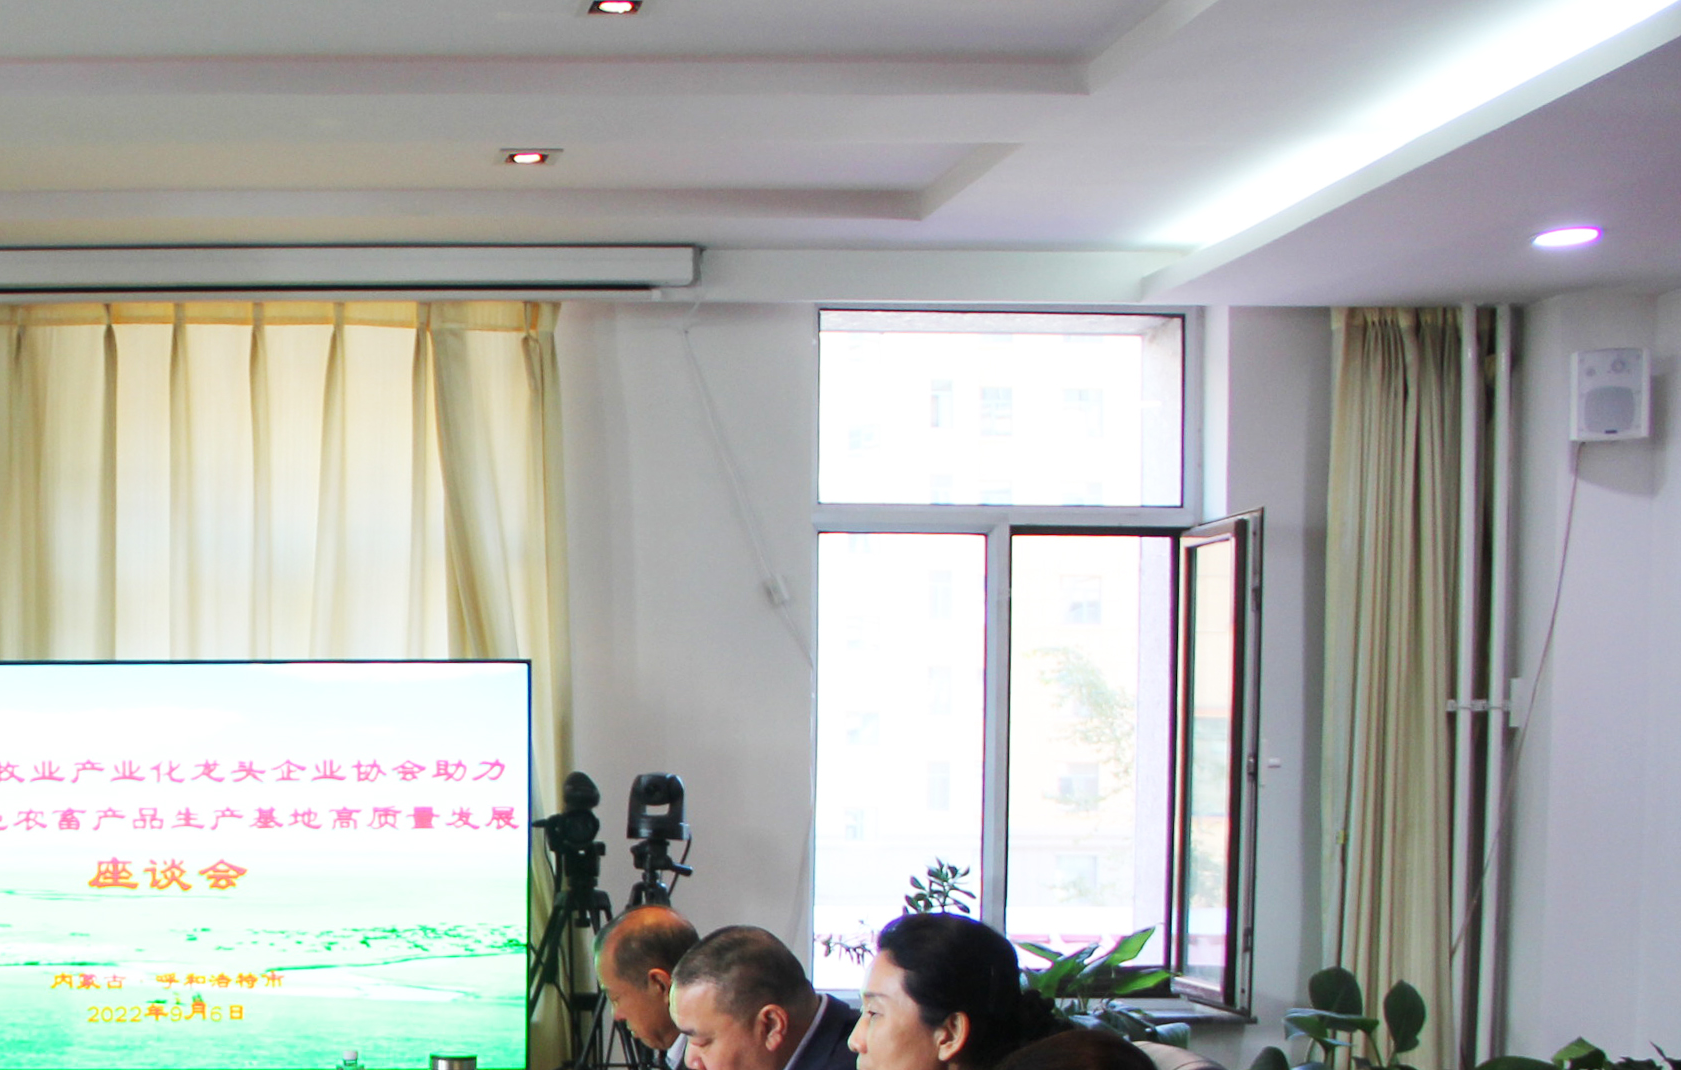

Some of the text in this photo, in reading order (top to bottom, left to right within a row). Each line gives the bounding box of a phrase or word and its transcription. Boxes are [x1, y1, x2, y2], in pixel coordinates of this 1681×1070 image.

[87, 857, 248, 891] 座谈会
[86, 1000, 244, 1023] 2022年9月6日
